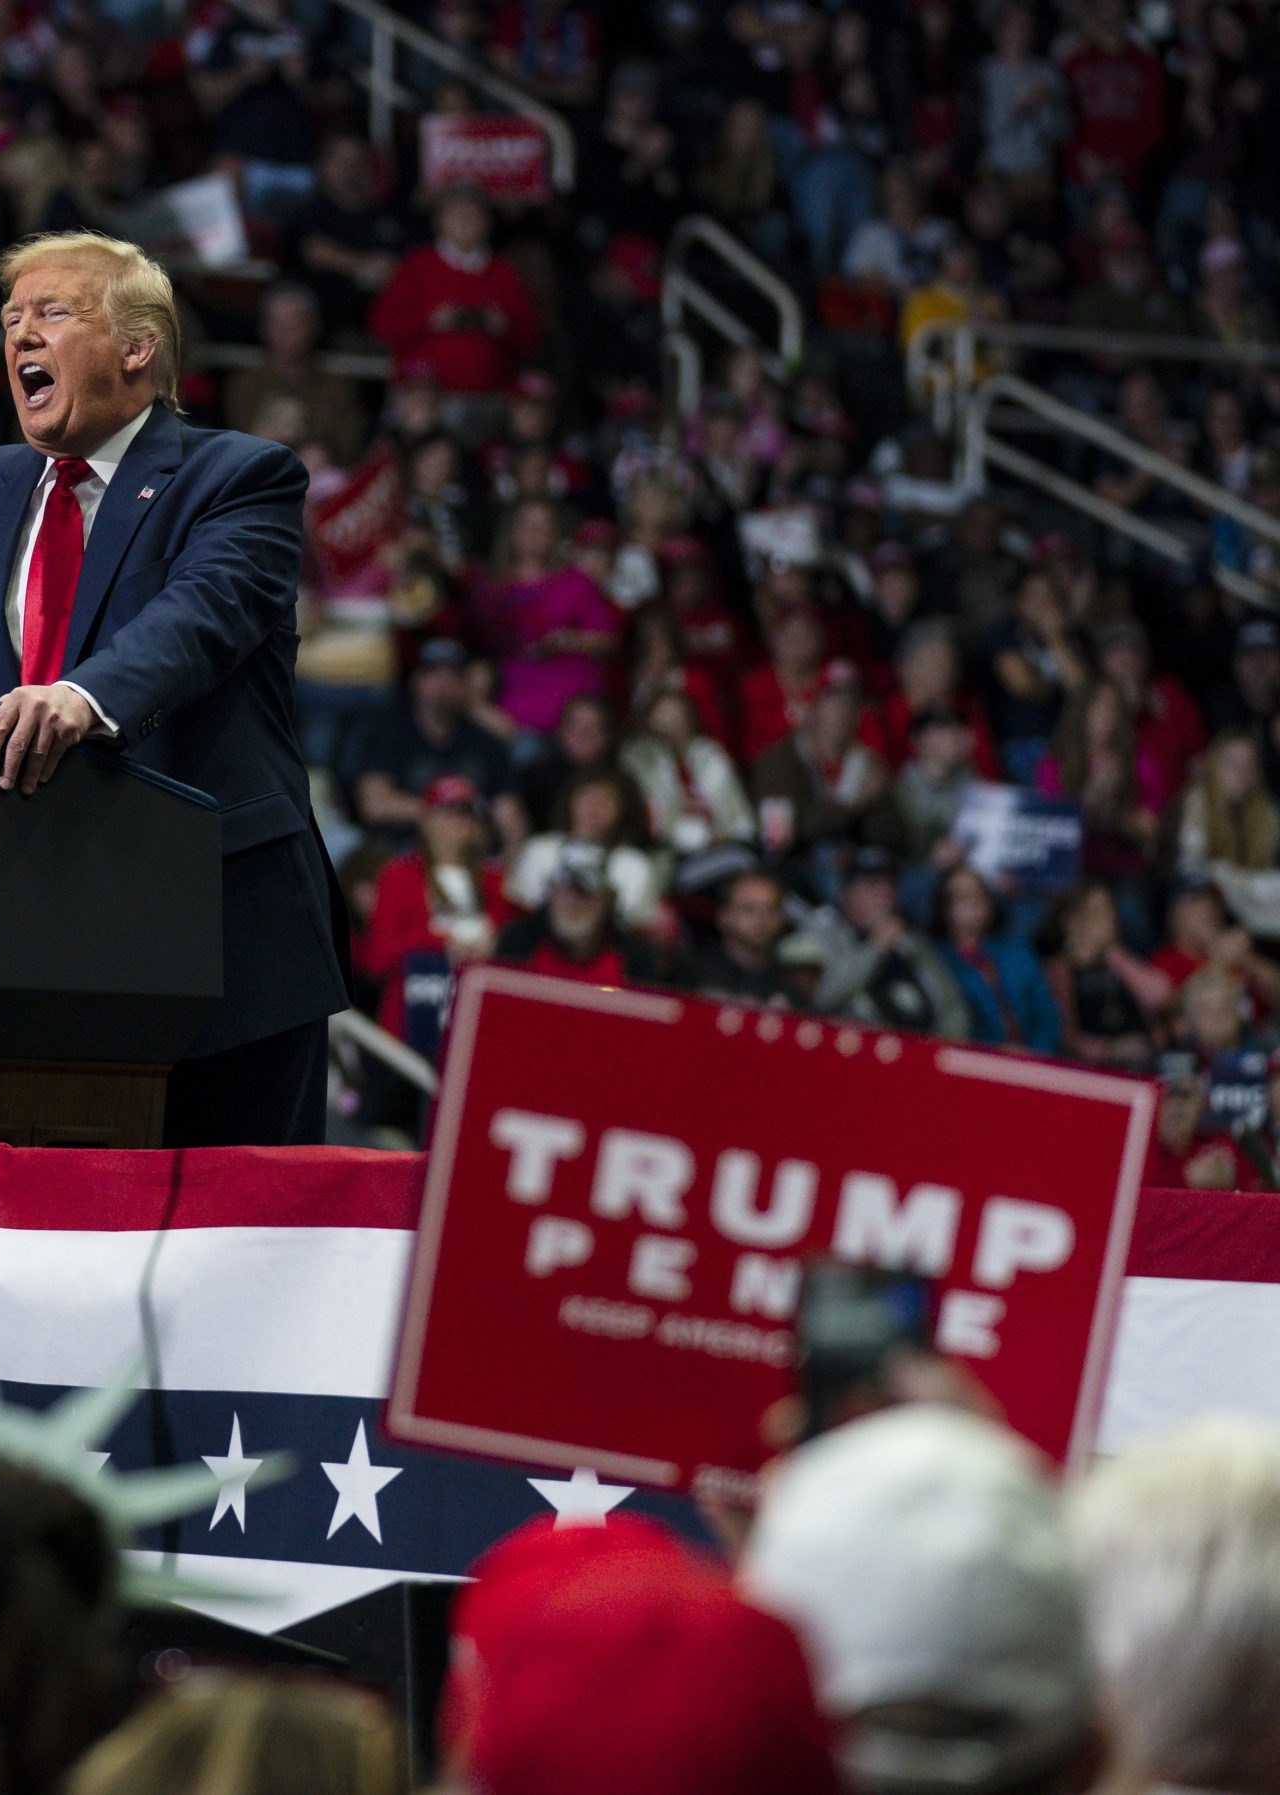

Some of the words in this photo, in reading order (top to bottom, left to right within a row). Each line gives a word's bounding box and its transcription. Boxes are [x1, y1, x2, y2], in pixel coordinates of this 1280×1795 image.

[488, 1106, 1077, 1292] TRUMP
[524, 1214, 1009, 1360] PENE
[656, 1309, 797, 1371] AMERIC
